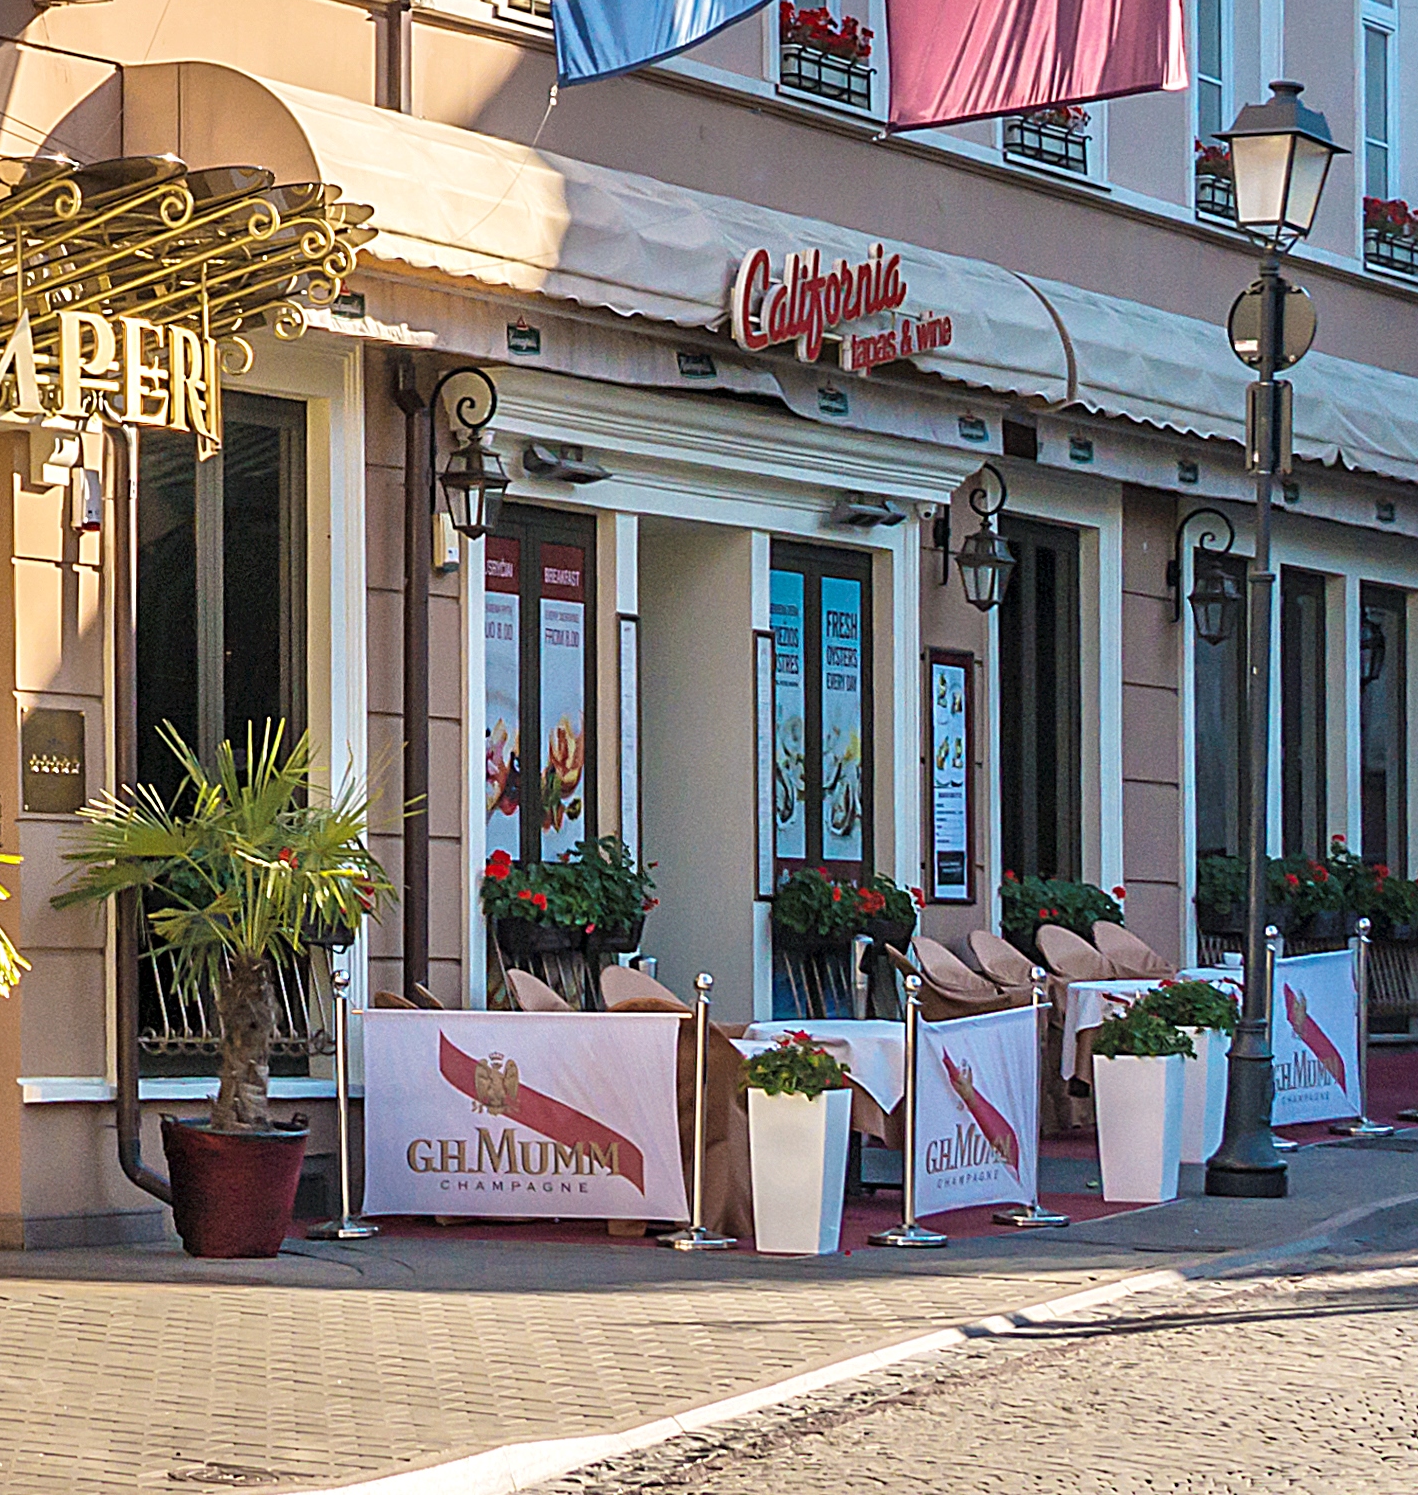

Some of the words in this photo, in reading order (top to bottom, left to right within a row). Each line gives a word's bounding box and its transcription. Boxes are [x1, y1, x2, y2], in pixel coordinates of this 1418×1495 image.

[733, 243, 907, 363] California
[851, 330, 897, 376] tapas
[901, 319, 913, 356] &
[915, 310, 952, 351] wine
[544, 566, 580, 587] BREAKFAST
[826, 610, 858, 641] FRESH
[826, 644, 858, 668] OYSTERS
[440, 1180, 588, 1194] CHAMPAGNE
